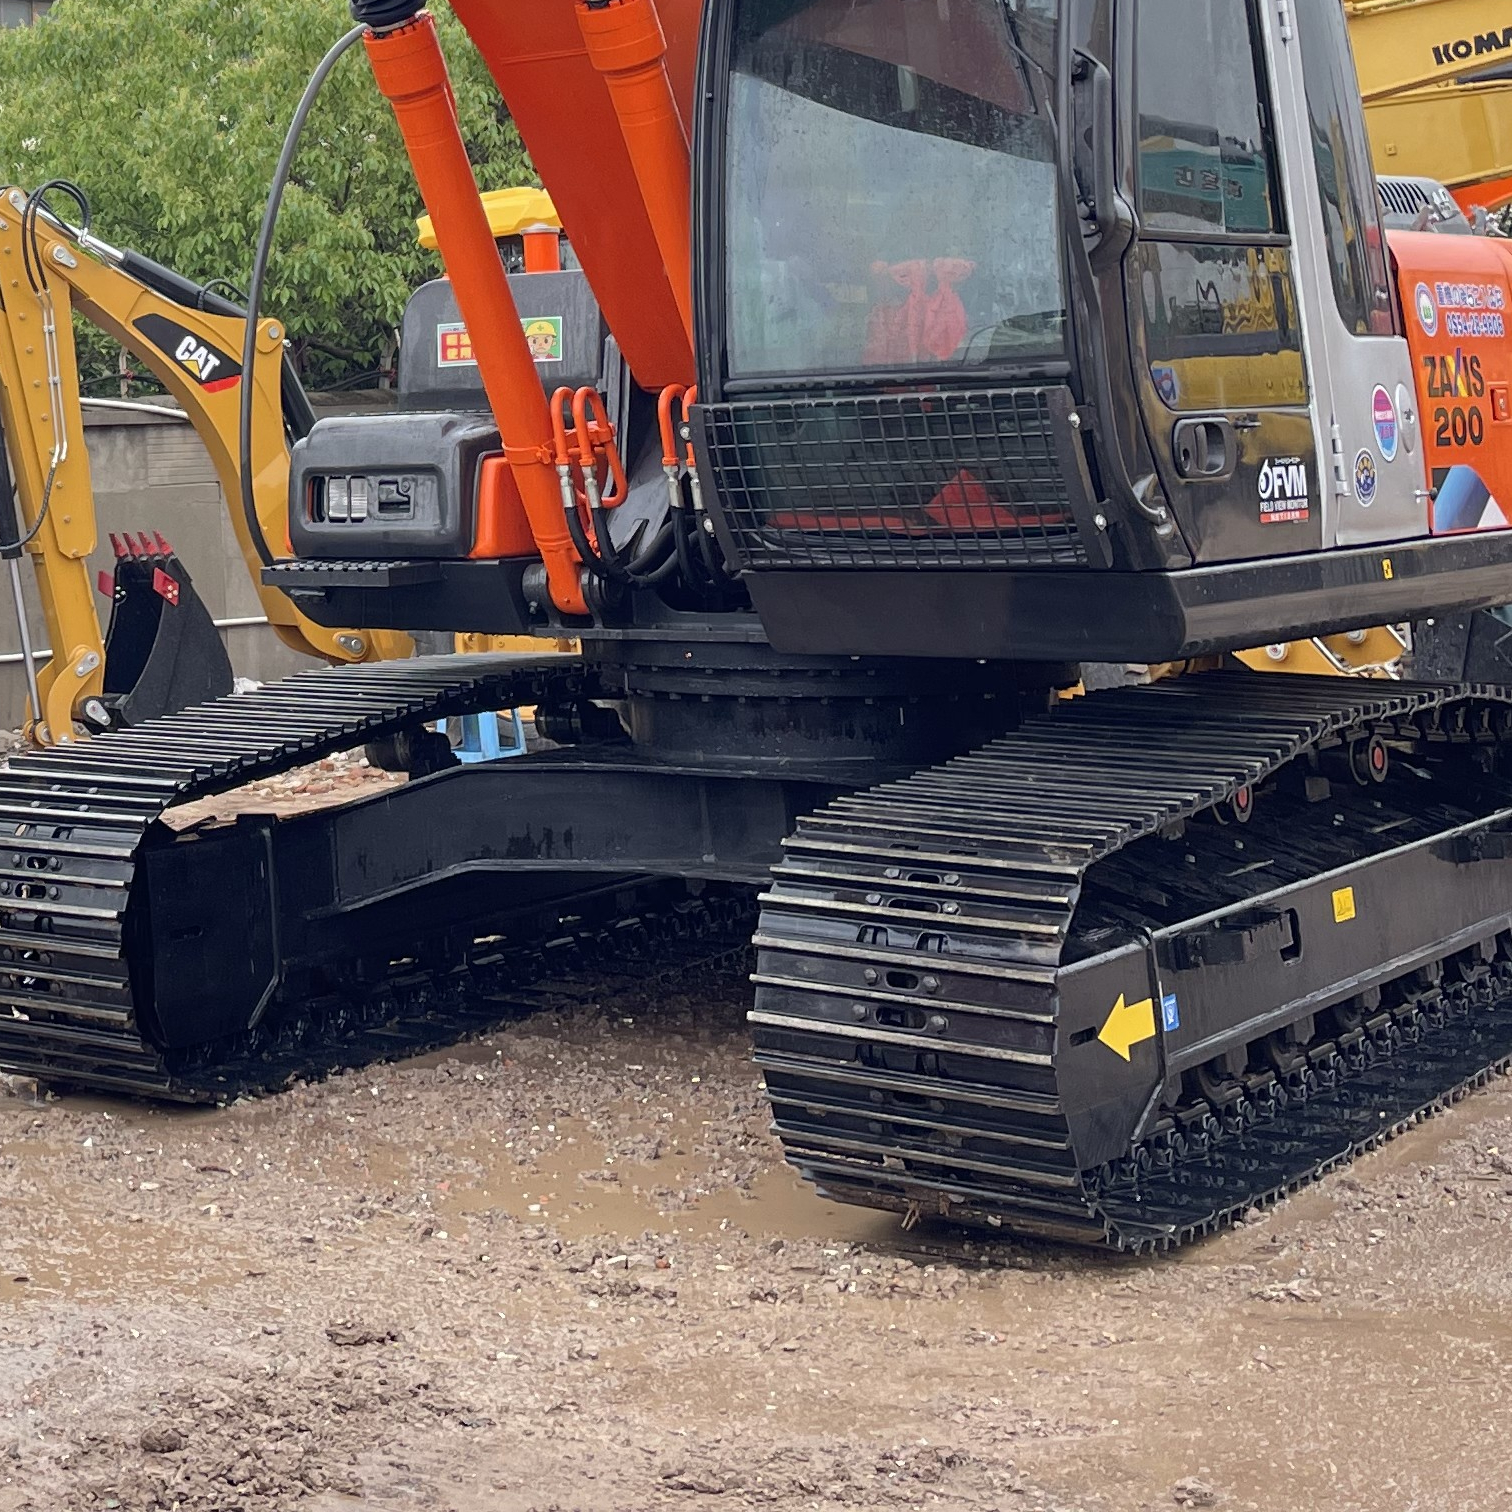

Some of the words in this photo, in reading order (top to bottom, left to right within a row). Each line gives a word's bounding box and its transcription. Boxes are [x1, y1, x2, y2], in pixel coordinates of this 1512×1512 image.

[175, 335, 221, 381] CAT
[1423, 348, 1485, 398] ZAXIS
[1434, 405, 1484, 447] 200
